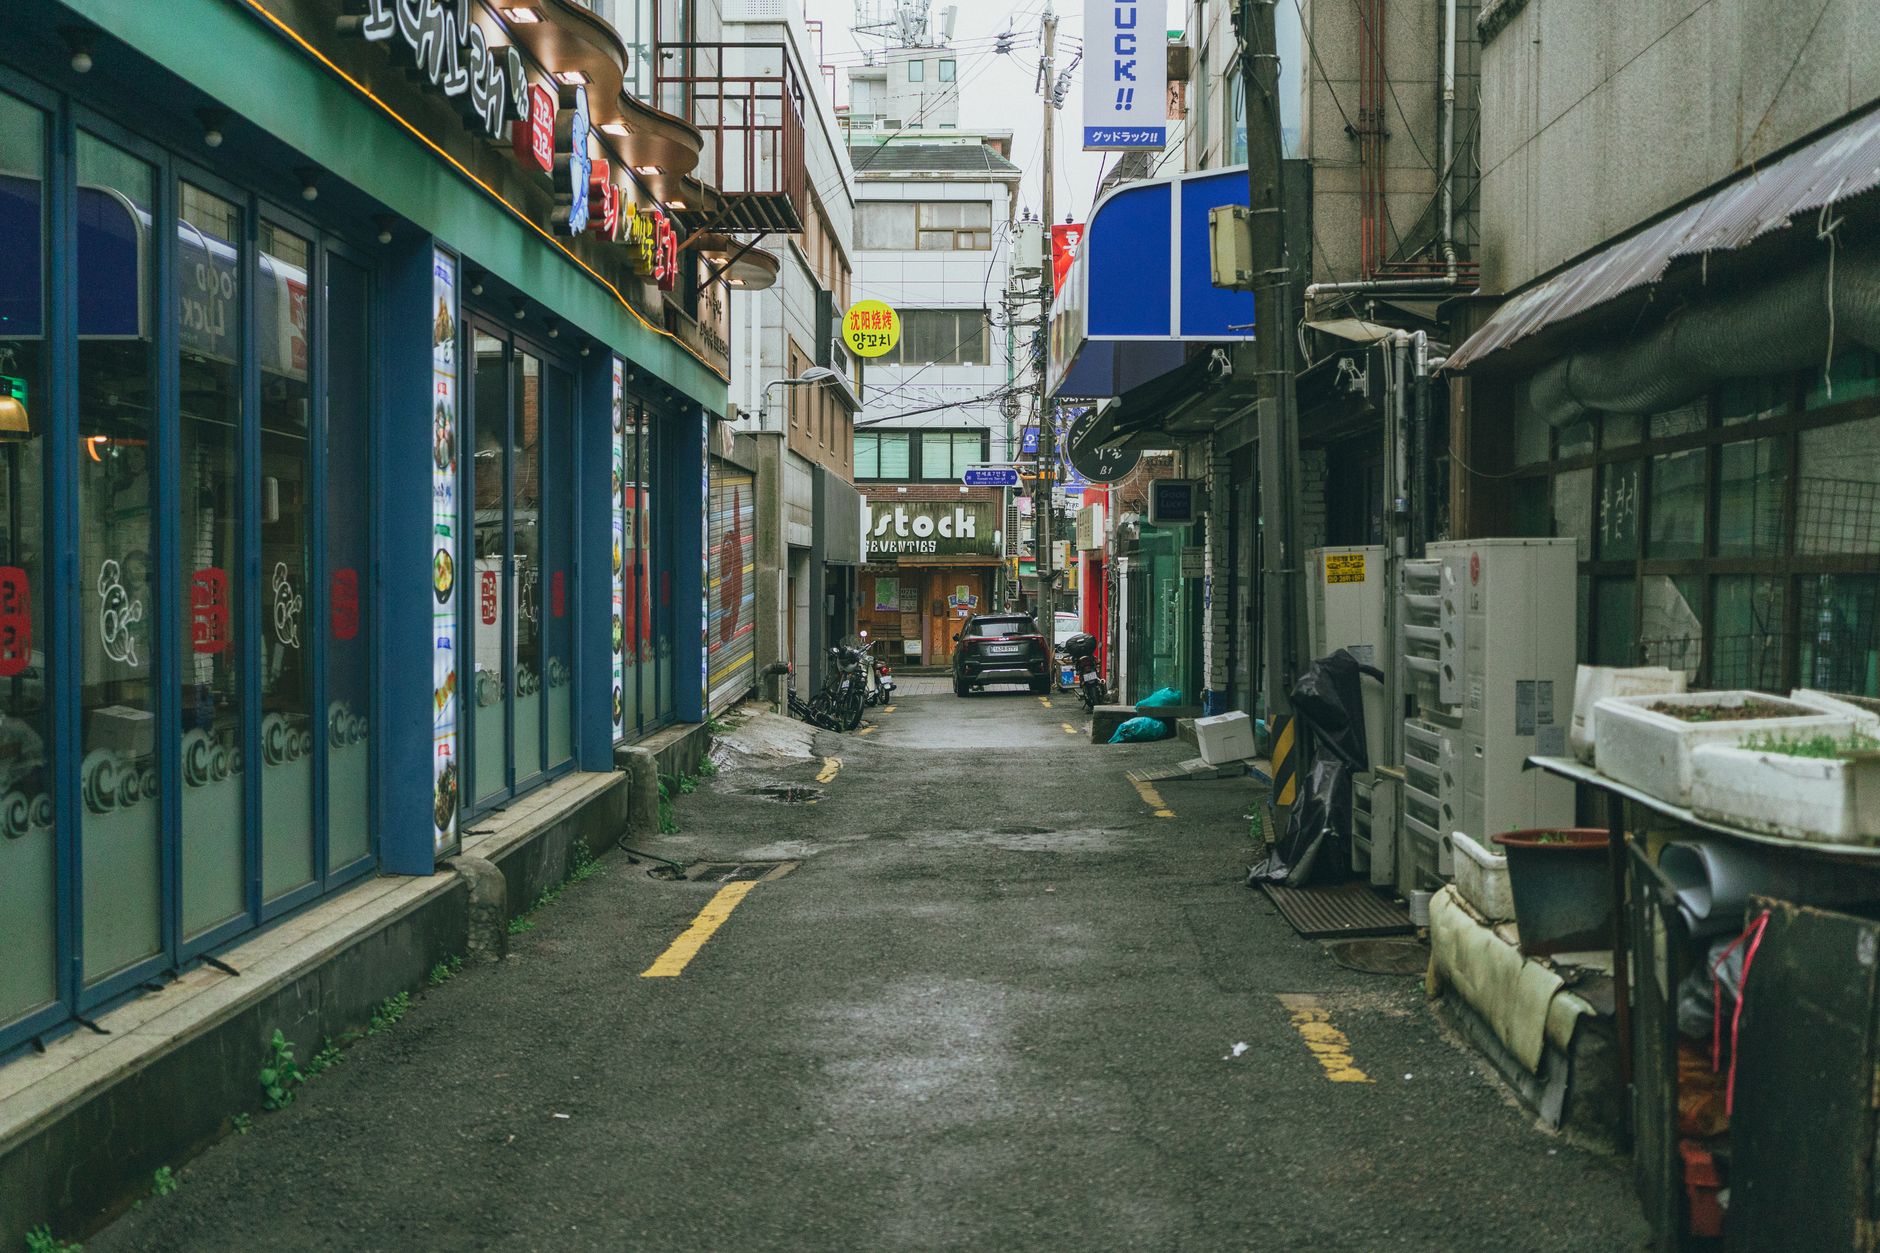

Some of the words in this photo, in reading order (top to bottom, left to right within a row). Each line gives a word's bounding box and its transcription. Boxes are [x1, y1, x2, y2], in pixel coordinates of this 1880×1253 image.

[1115, 0, 1137, 110] UCK!!
[1092, 130, 1158, 143] グッドラック!!
[850, 310, 892, 330] 沈阳烧烤
[852, 332, 891, 350] 양꼬치
[866, 507, 976, 538] stock
